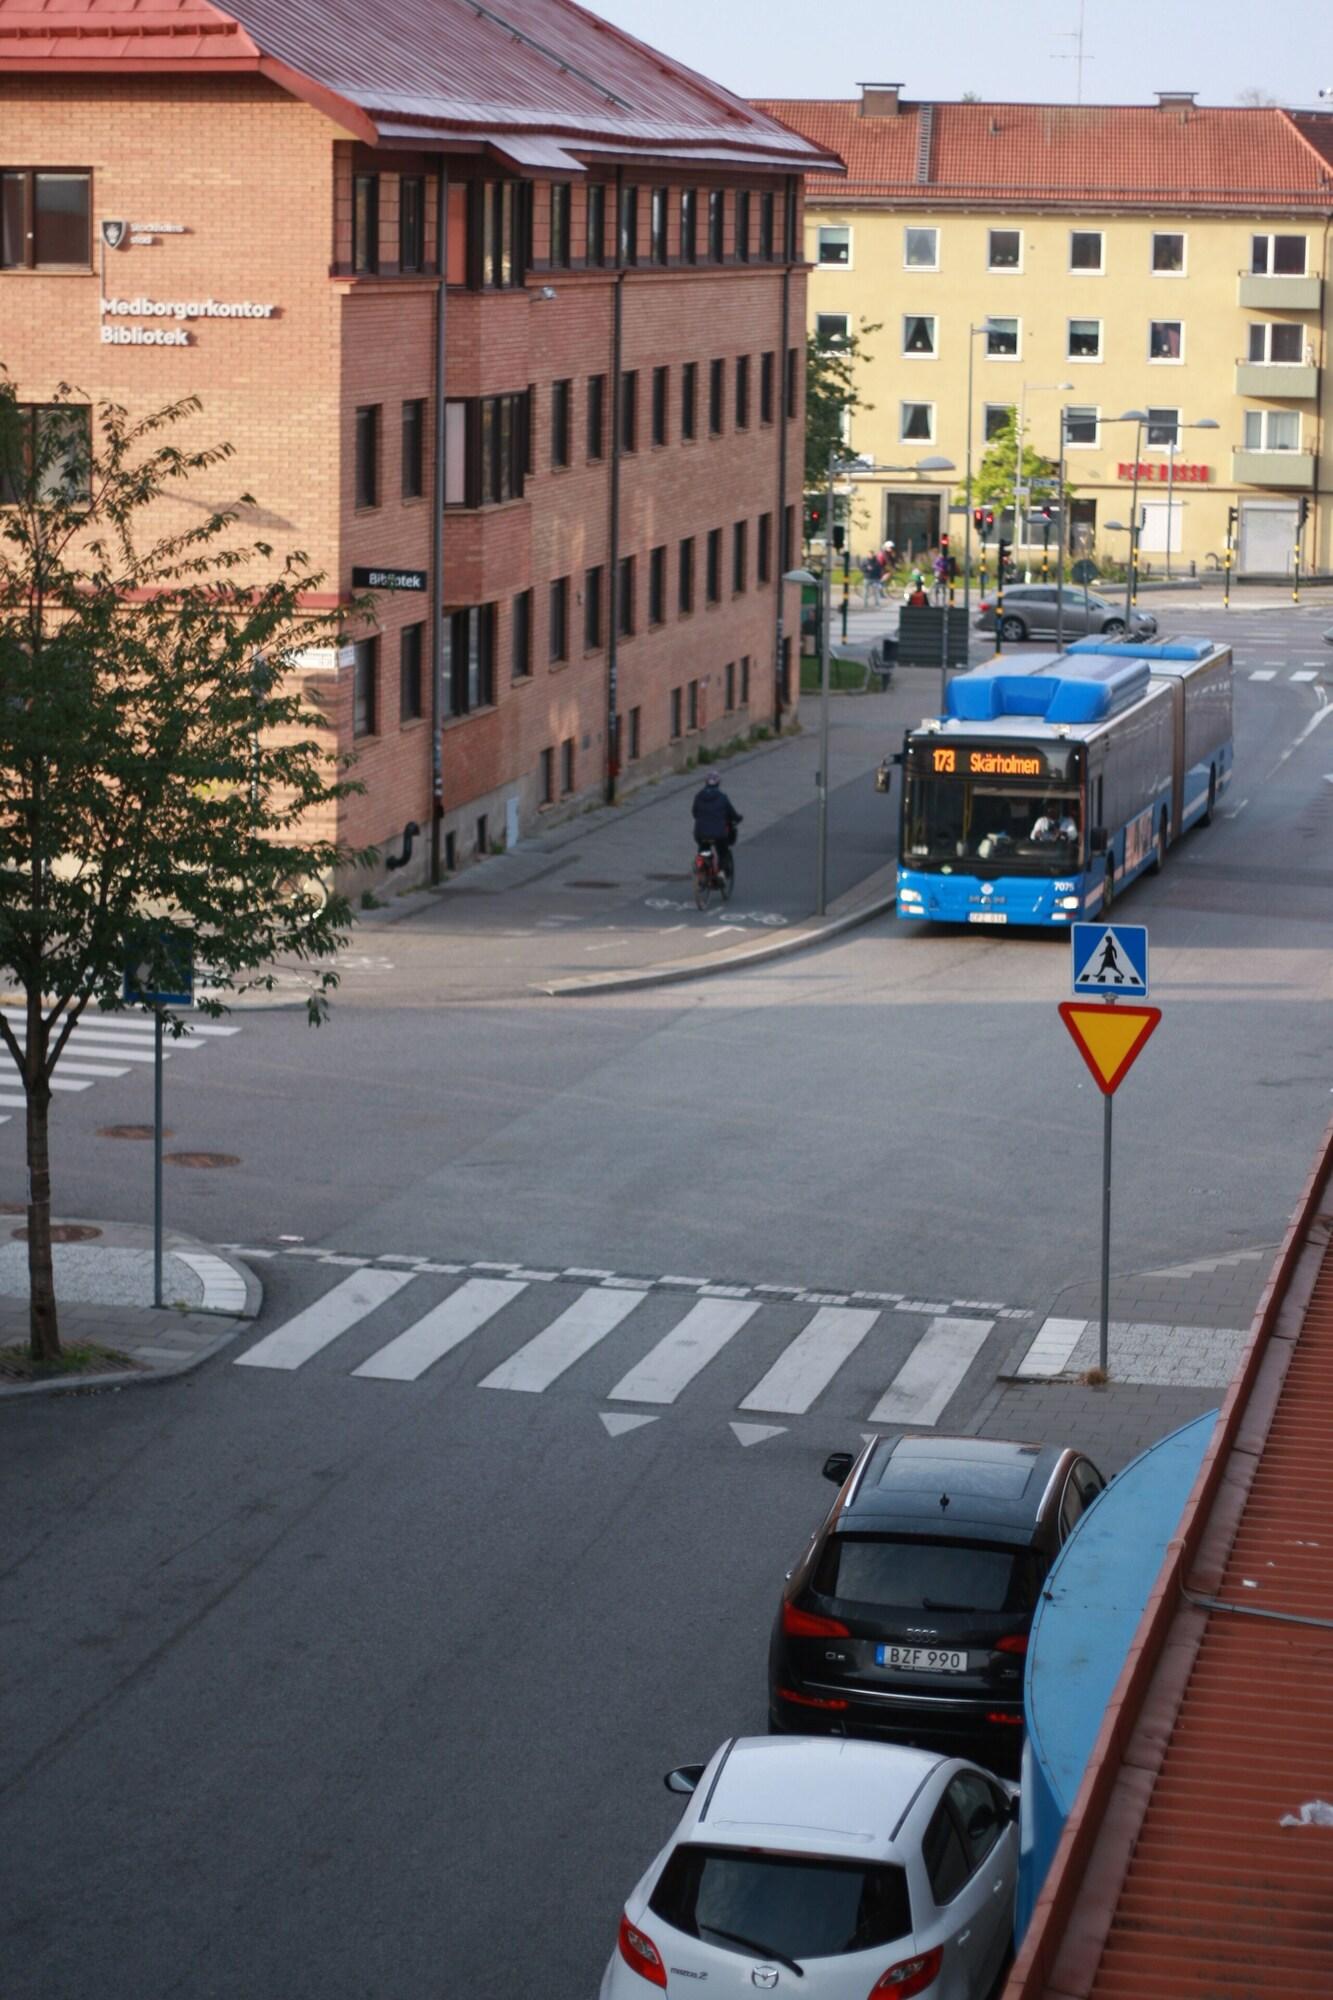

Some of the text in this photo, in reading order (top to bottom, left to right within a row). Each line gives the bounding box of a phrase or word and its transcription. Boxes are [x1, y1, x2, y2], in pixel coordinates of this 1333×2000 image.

[101, 299, 273, 320] Medborgarkontor
[101, 326, 188, 345] Bibliotek
[933, 749, 1040, 774] 173 Skärholmen
[890, 1647, 961, 1668] BZF 990
